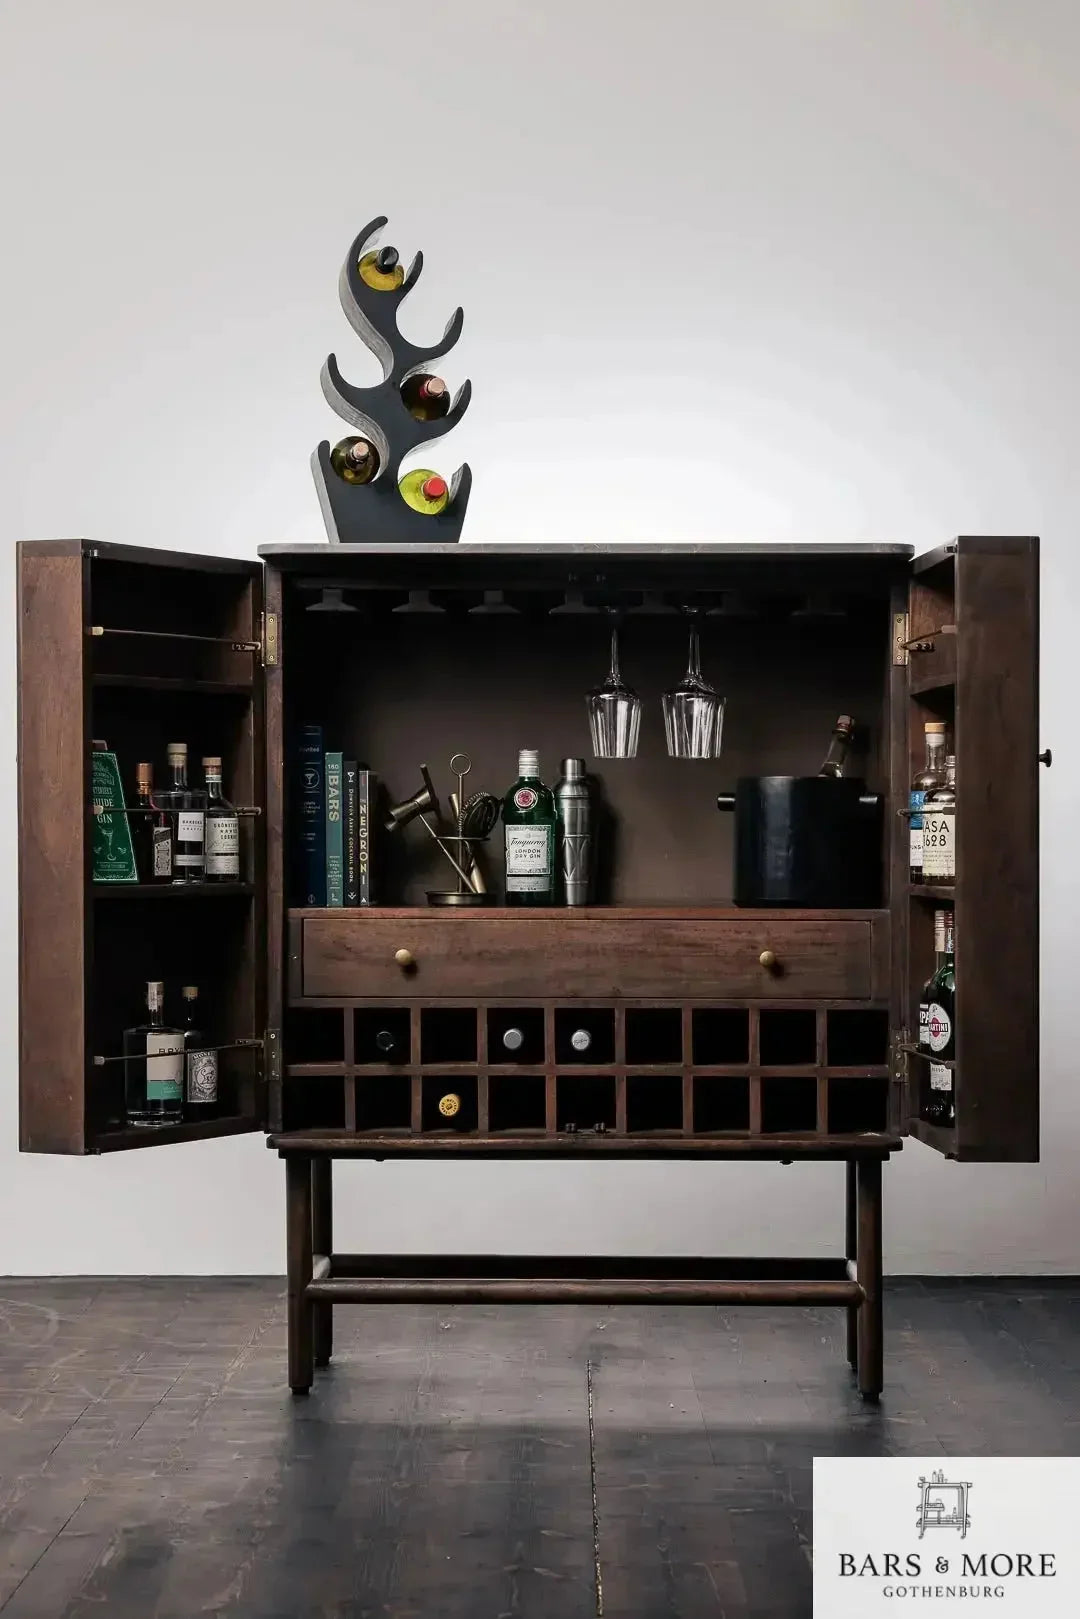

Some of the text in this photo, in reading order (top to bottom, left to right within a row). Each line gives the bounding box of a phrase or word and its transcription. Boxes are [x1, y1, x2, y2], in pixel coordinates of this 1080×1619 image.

[328, 775, 340, 823] BARS
[97, 813, 113, 824] GIN
[359, 804, 368, 885] NEGRONI
[510, 837, 546, 848] Tanqueray
[923, 834, 947, 847] 1628
